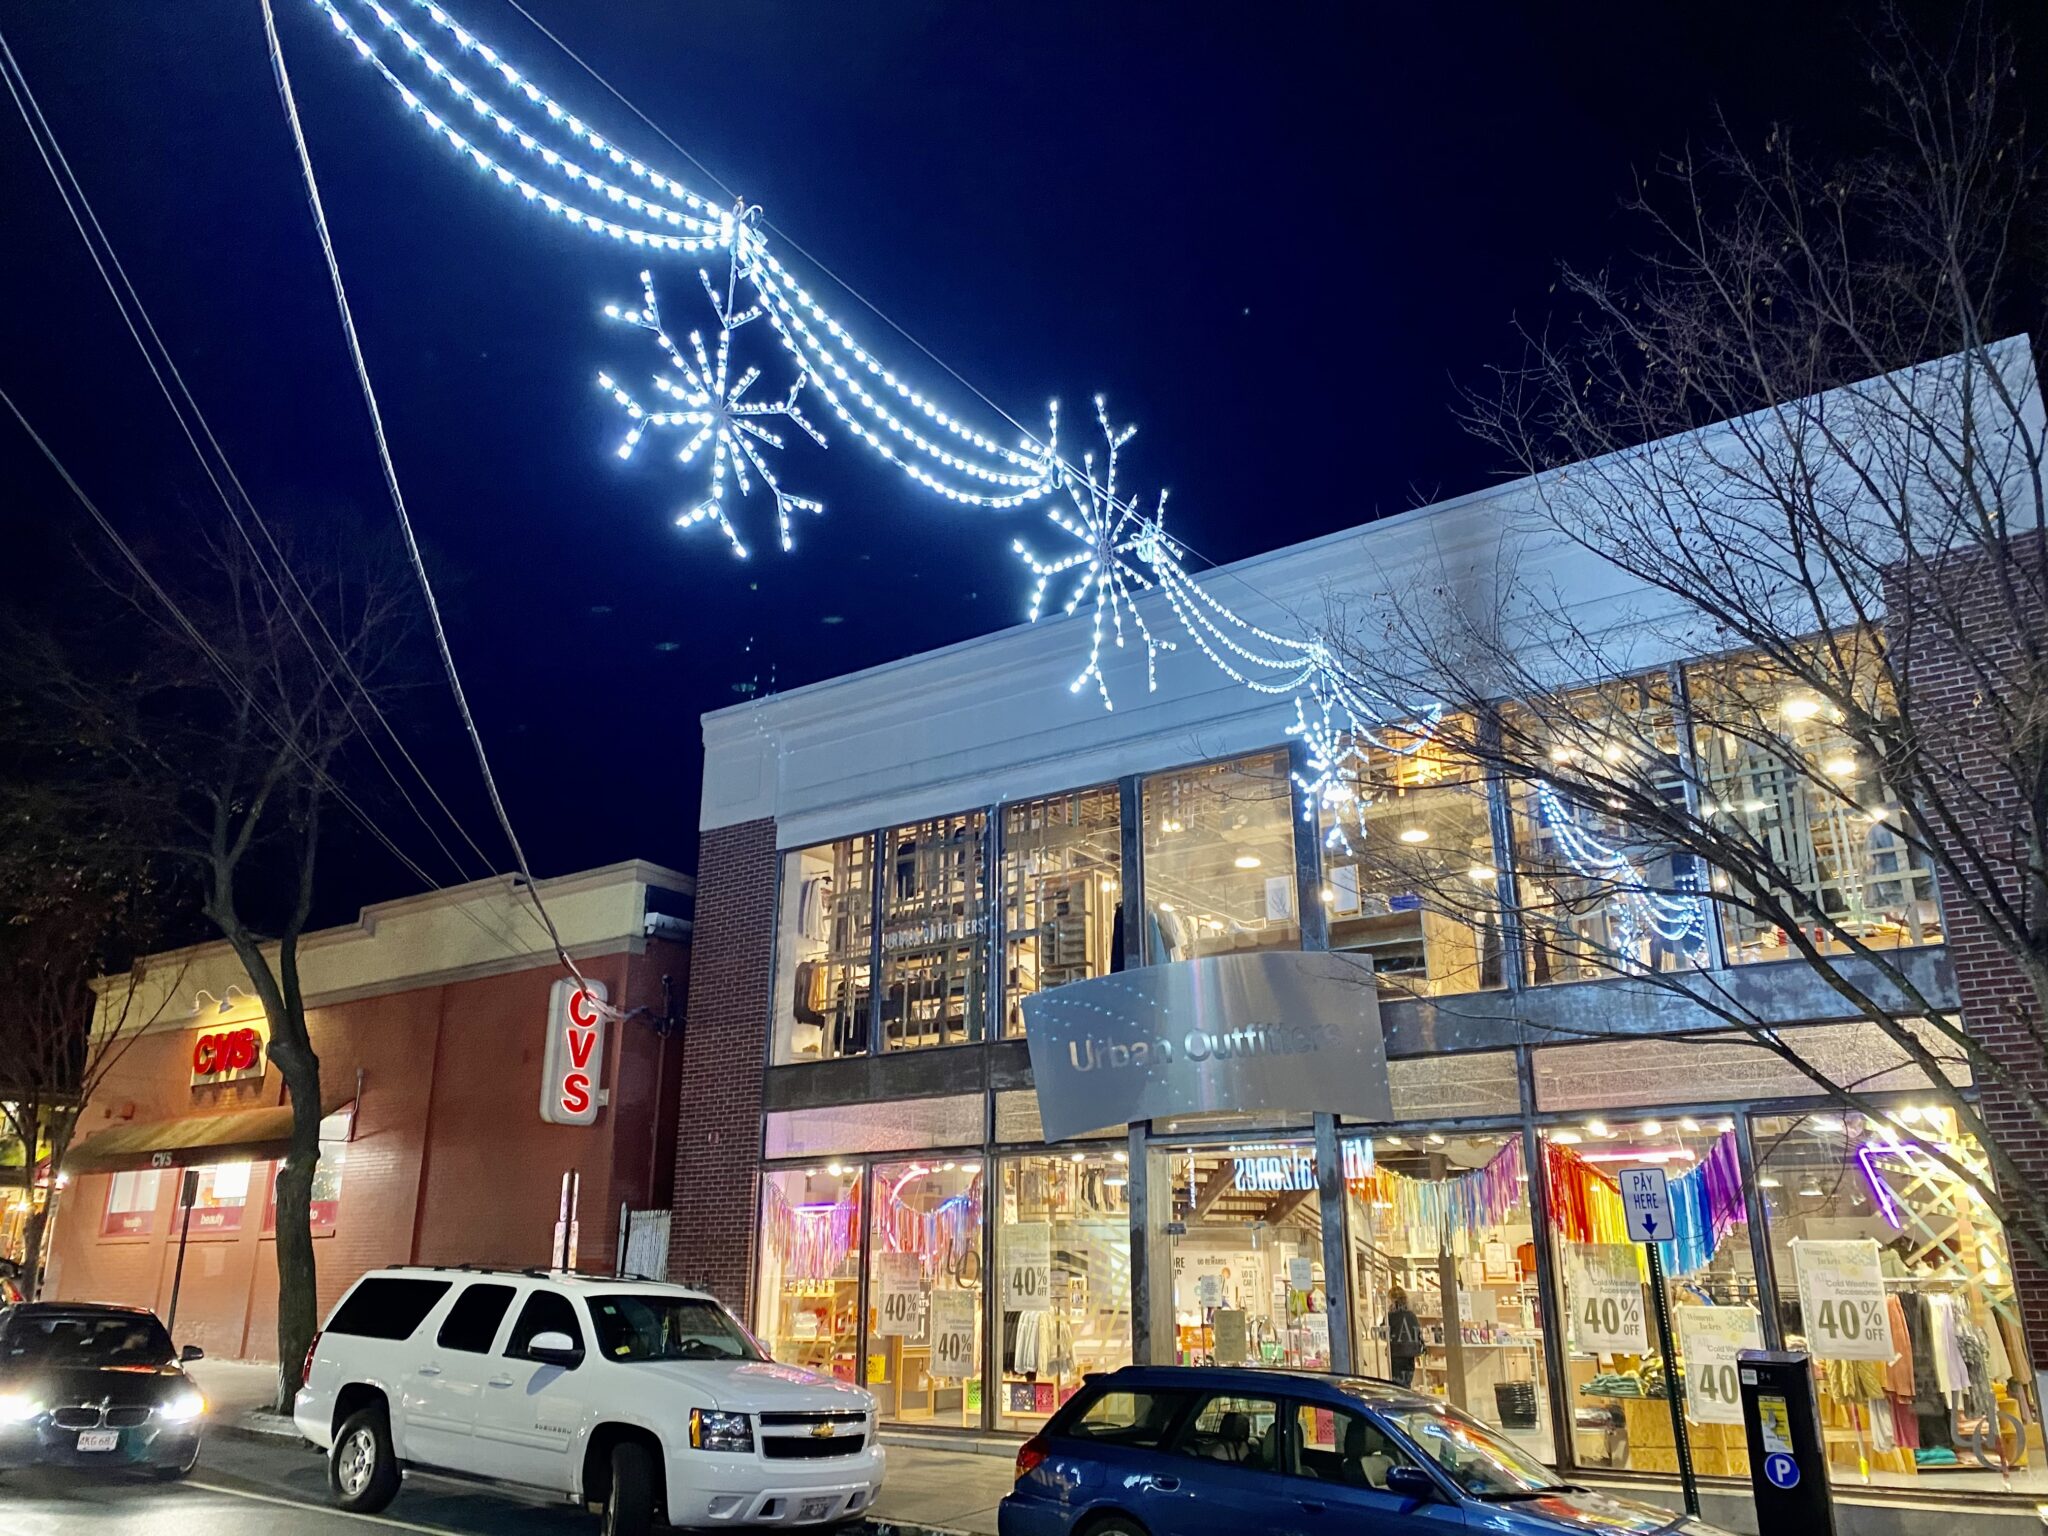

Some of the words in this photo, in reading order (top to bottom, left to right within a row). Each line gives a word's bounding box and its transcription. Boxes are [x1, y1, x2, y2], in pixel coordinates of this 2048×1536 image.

[193, 1028, 258, 1075] CVS
[561, 988, 599, 1114] CVS
[1069, 1035, 1173, 1072] Urban
[1184, 1022, 1342, 1062] Outfitters
[152, 1151, 172, 1167] CVS
[1633, 1174, 1653, 1191] PAY
[1633, 1192, 1659, 1210] HERE
[200, 1213, 224, 1227] beauty
[1012, 1266, 1048, 1296] 40%
[1037, 1287, 1047, 1296] OFF
[1835, 1288, 1882, 1296] Accessories
[885, 1293, 917, 1321] 40%
[907, 1313, 916, 1322] OFF
[1584, 1297, 1639, 1335] 40%
[1623, 1324, 1640, 1336] OFF
[1818, 1299, 1883, 1340] 40%
[1865, 1328, 1885, 1341] OFF
[938, 1332, 972, 1361] 40%
[1775, 1459, 1791, 1483] P
